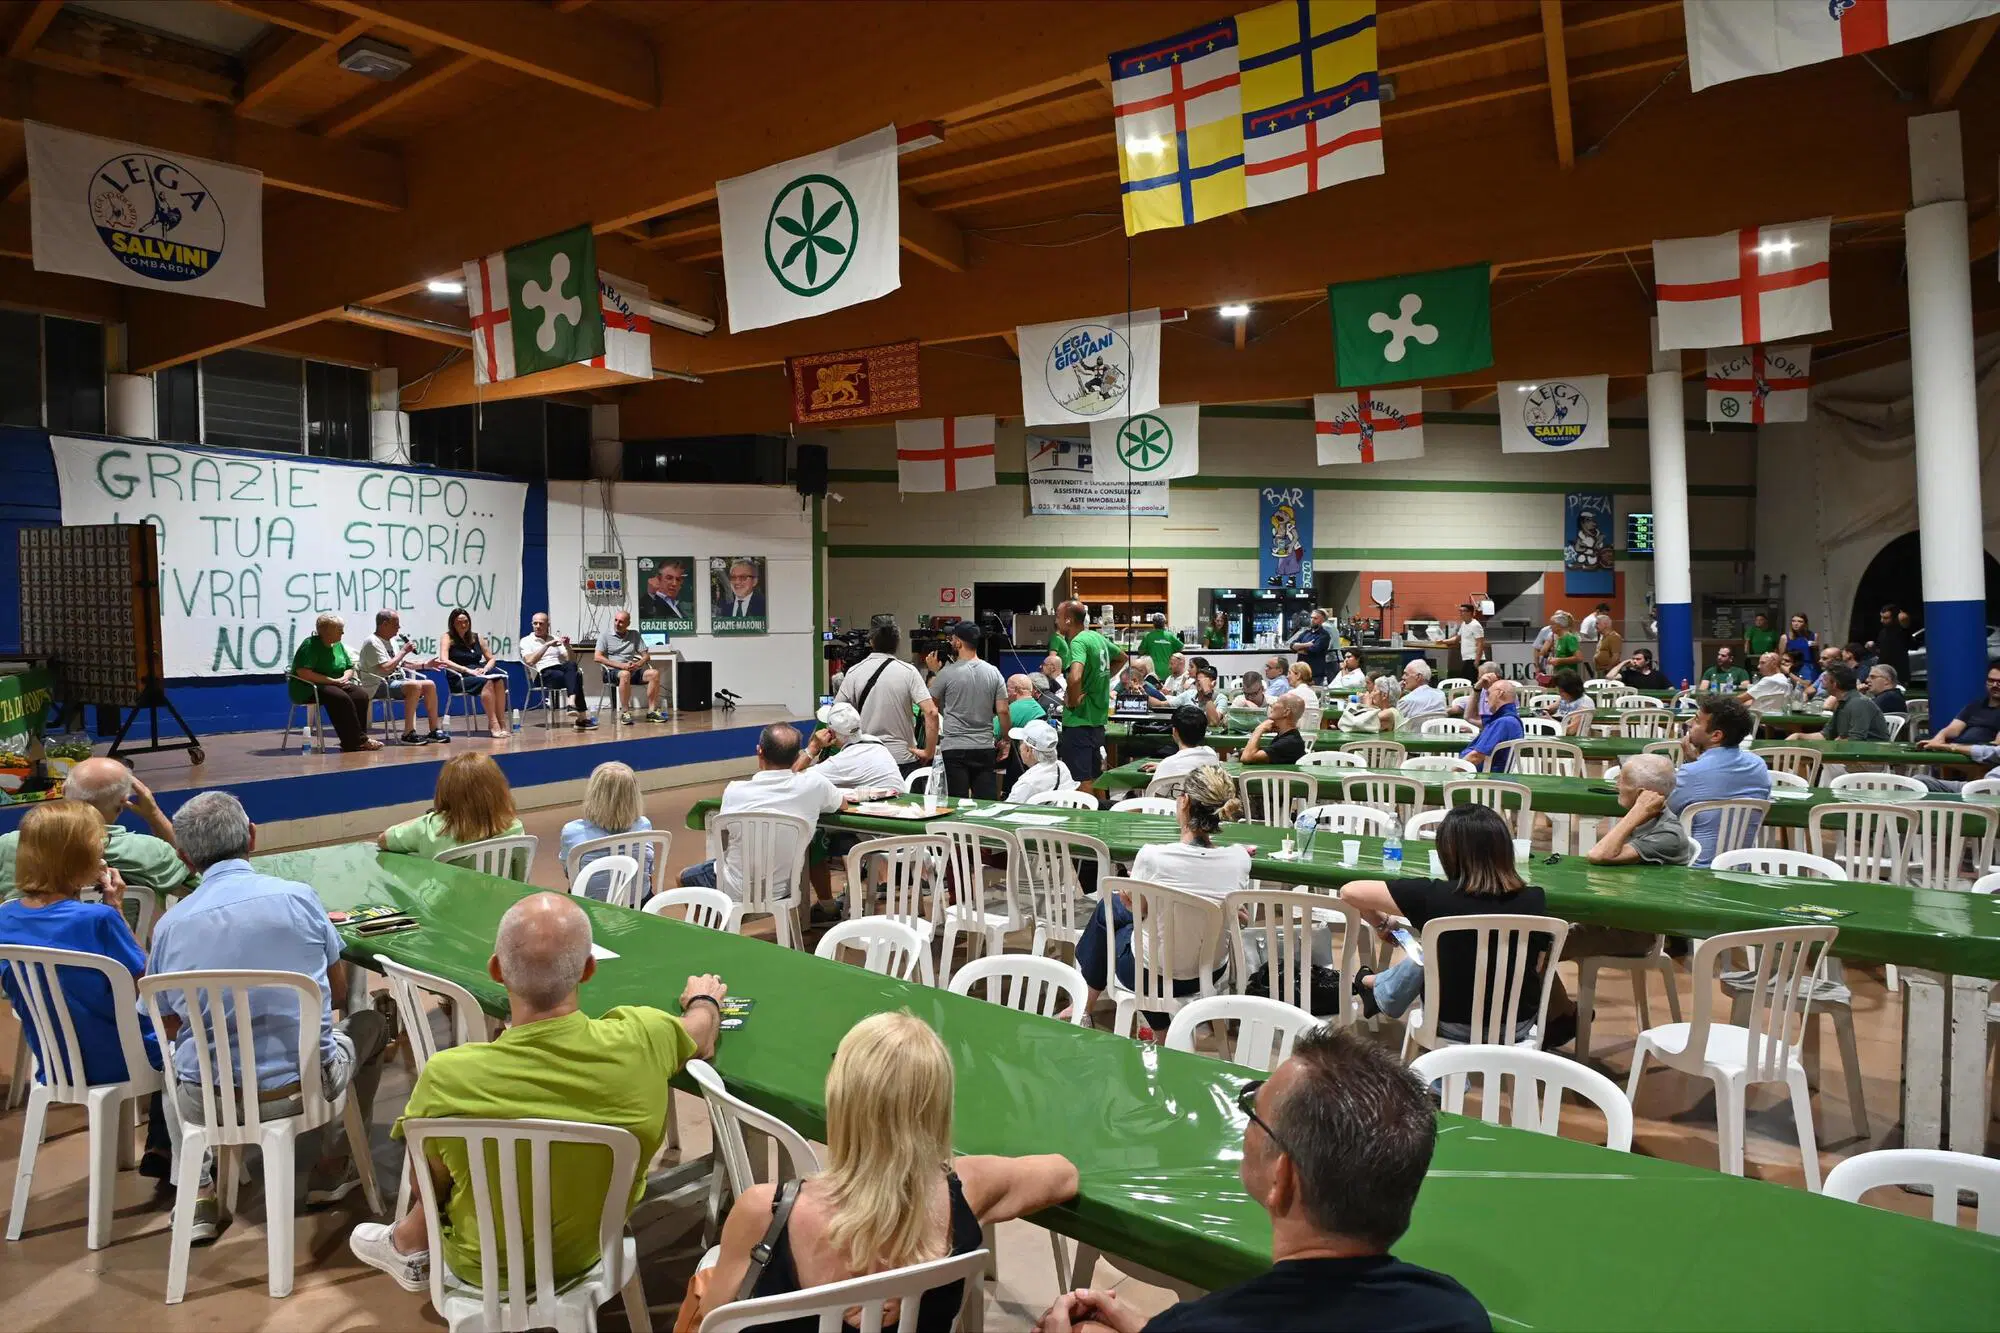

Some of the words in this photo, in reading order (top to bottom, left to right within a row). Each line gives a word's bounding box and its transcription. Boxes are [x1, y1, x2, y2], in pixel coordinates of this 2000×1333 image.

[101, 158, 206, 213] LEGA
[111, 232, 208, 269] SALVINI
[123, 255, 198, 276] LOMBARDIA
[1054, 331, 1091, 359] LEGA
[1055, 332, 1114, 371] GIOVANI
[1715, 355, 1752, 381] LEGA
[1529, 384, 1581, 407] LEGA
[1534, 425, 1581, 437] SALVINI
[97, 450, 320, 508] GRAZIE
[1053, 487, 1093, 495] ASSISTENZA
[1263, 488, 1305, 508] BAR
[200, 516, 294, 560] TUA
[344, 522, 486, 566] STORIA
[160, 562, 263, 619] IVRÀ
[286, 568, 415, 613] SEMPRE
[436, 573, 497, 612] CON
[640, 621, 666, 631] GRAZIE
[713, 621, 735, 631] GRAZIE
[1501, 662, 1538, 681] LEG
